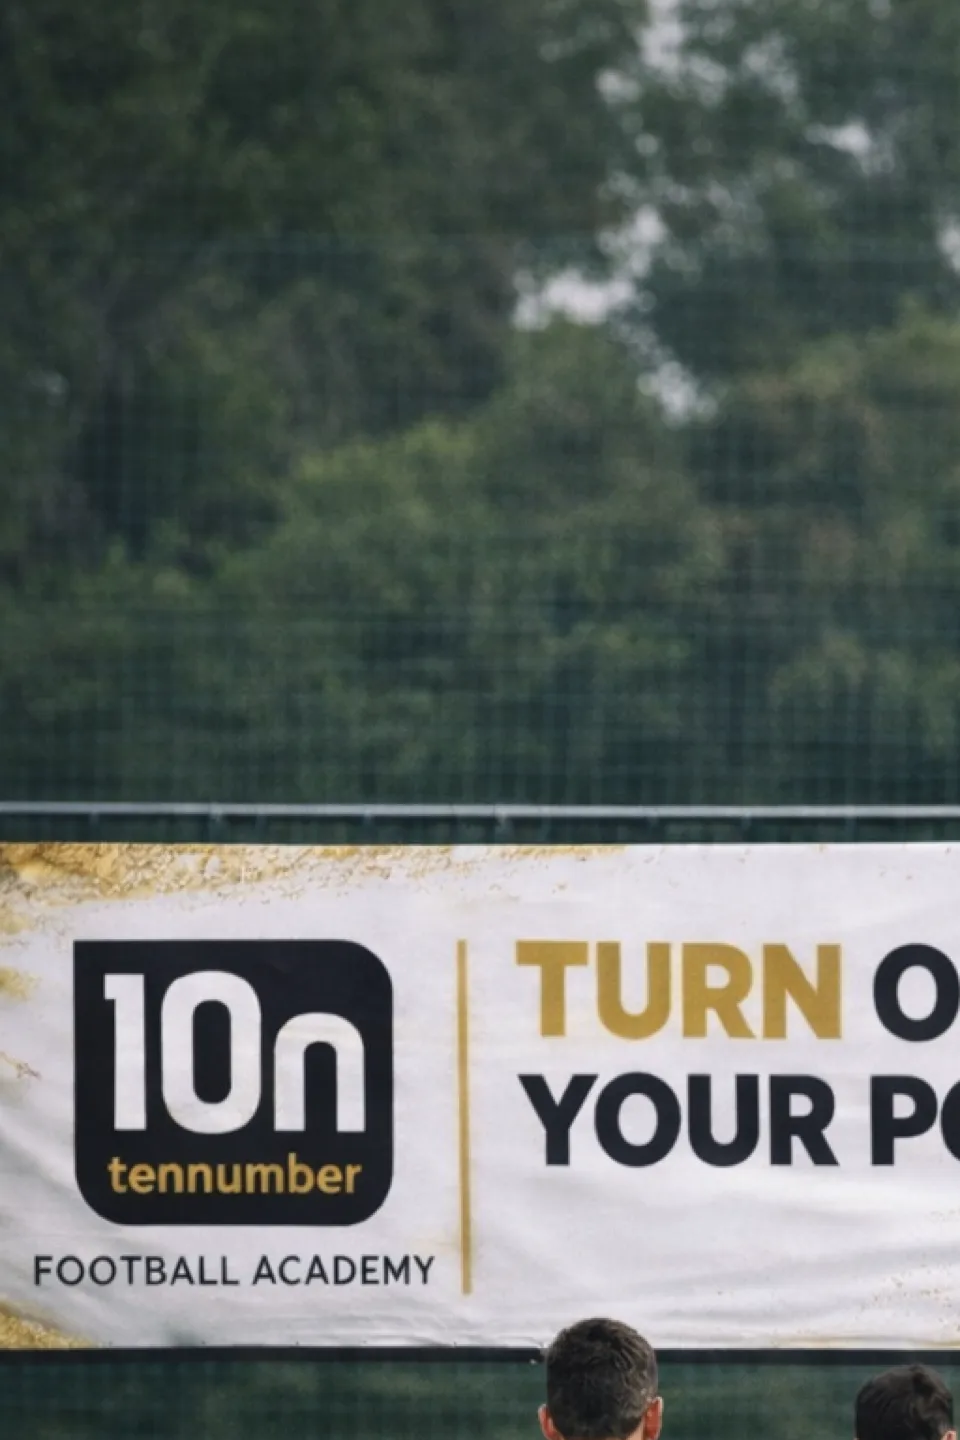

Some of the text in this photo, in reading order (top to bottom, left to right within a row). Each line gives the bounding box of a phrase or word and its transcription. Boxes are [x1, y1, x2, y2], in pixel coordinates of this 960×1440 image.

[515, 940, 843, 1041] TURN
[104, 970, 366, 1134] 10n
[517, 1070, 841, 1168] YOUR
[108, 1153, 362, 1194] tennumber
[33, 1254, 435, 1286] FOOTBALL ACADEMY
